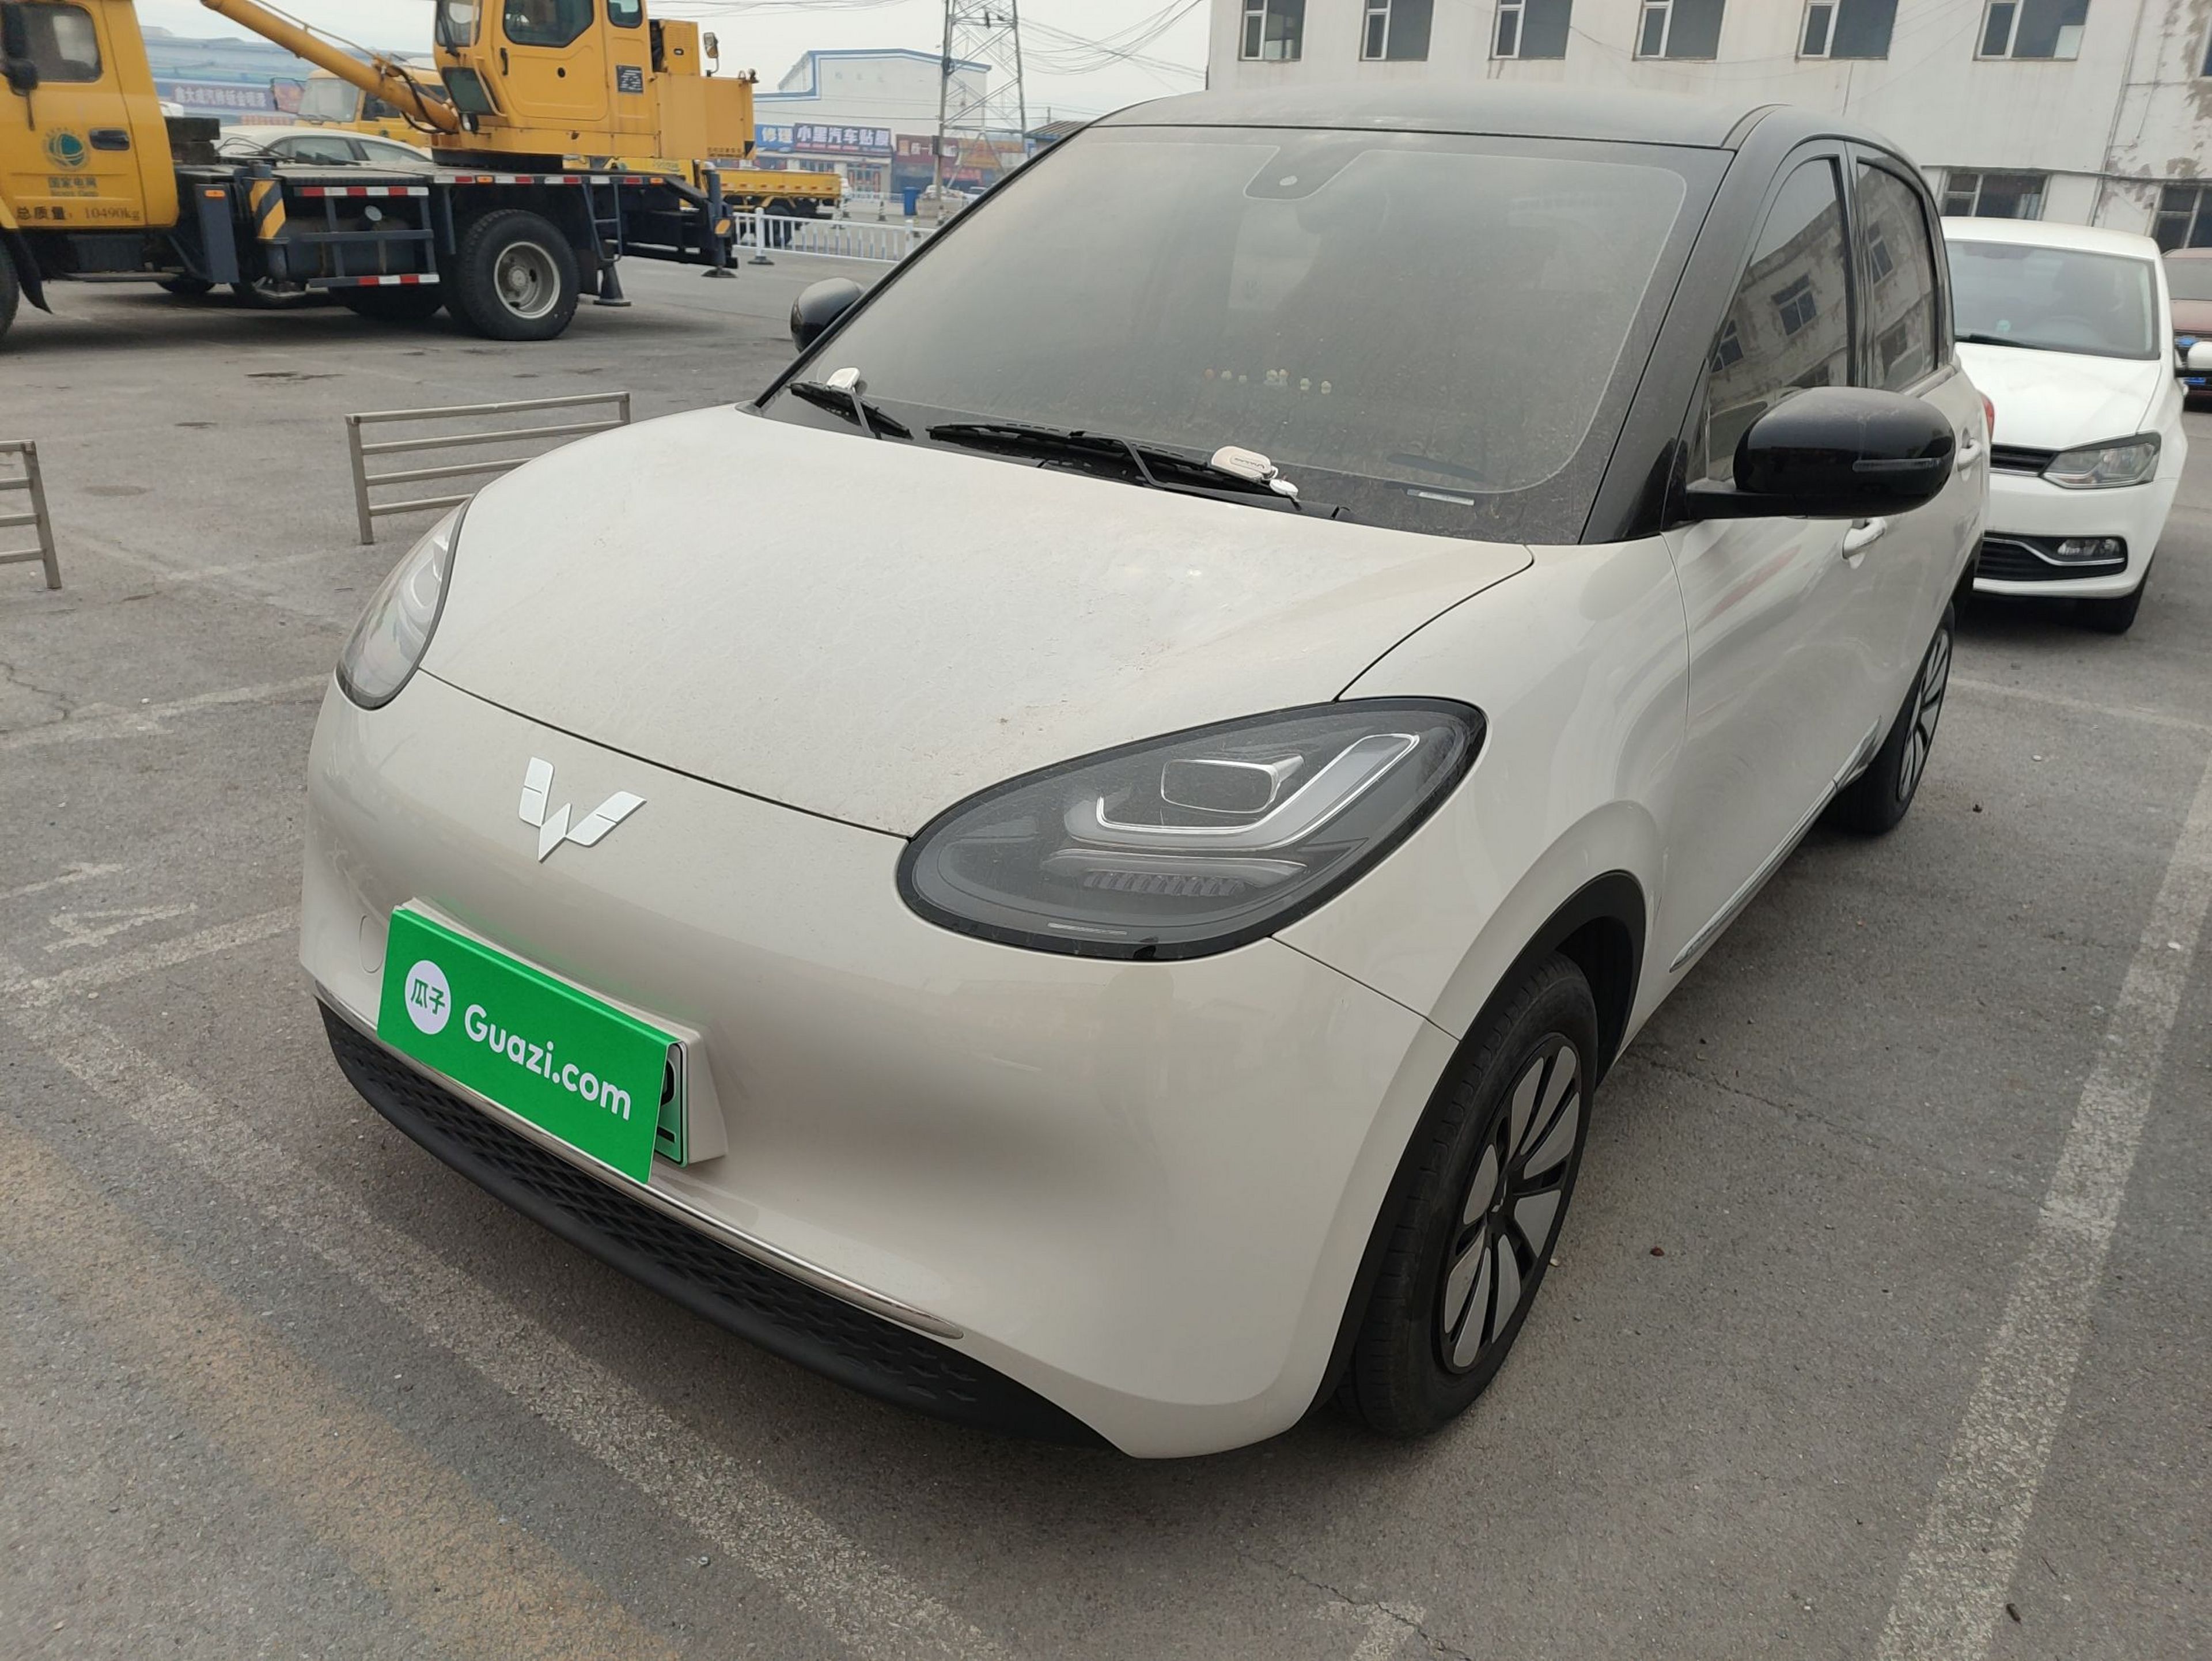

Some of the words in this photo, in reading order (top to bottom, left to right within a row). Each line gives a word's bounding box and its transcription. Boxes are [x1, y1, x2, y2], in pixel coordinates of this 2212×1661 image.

[797, 126, 889, 146] 小黑汽车贴膜
[85, 207, 140, 221] 10490kg
[411, 978, 446, 1016] 瓜子
[464, 1004, 631, 1121] Guazi.com
